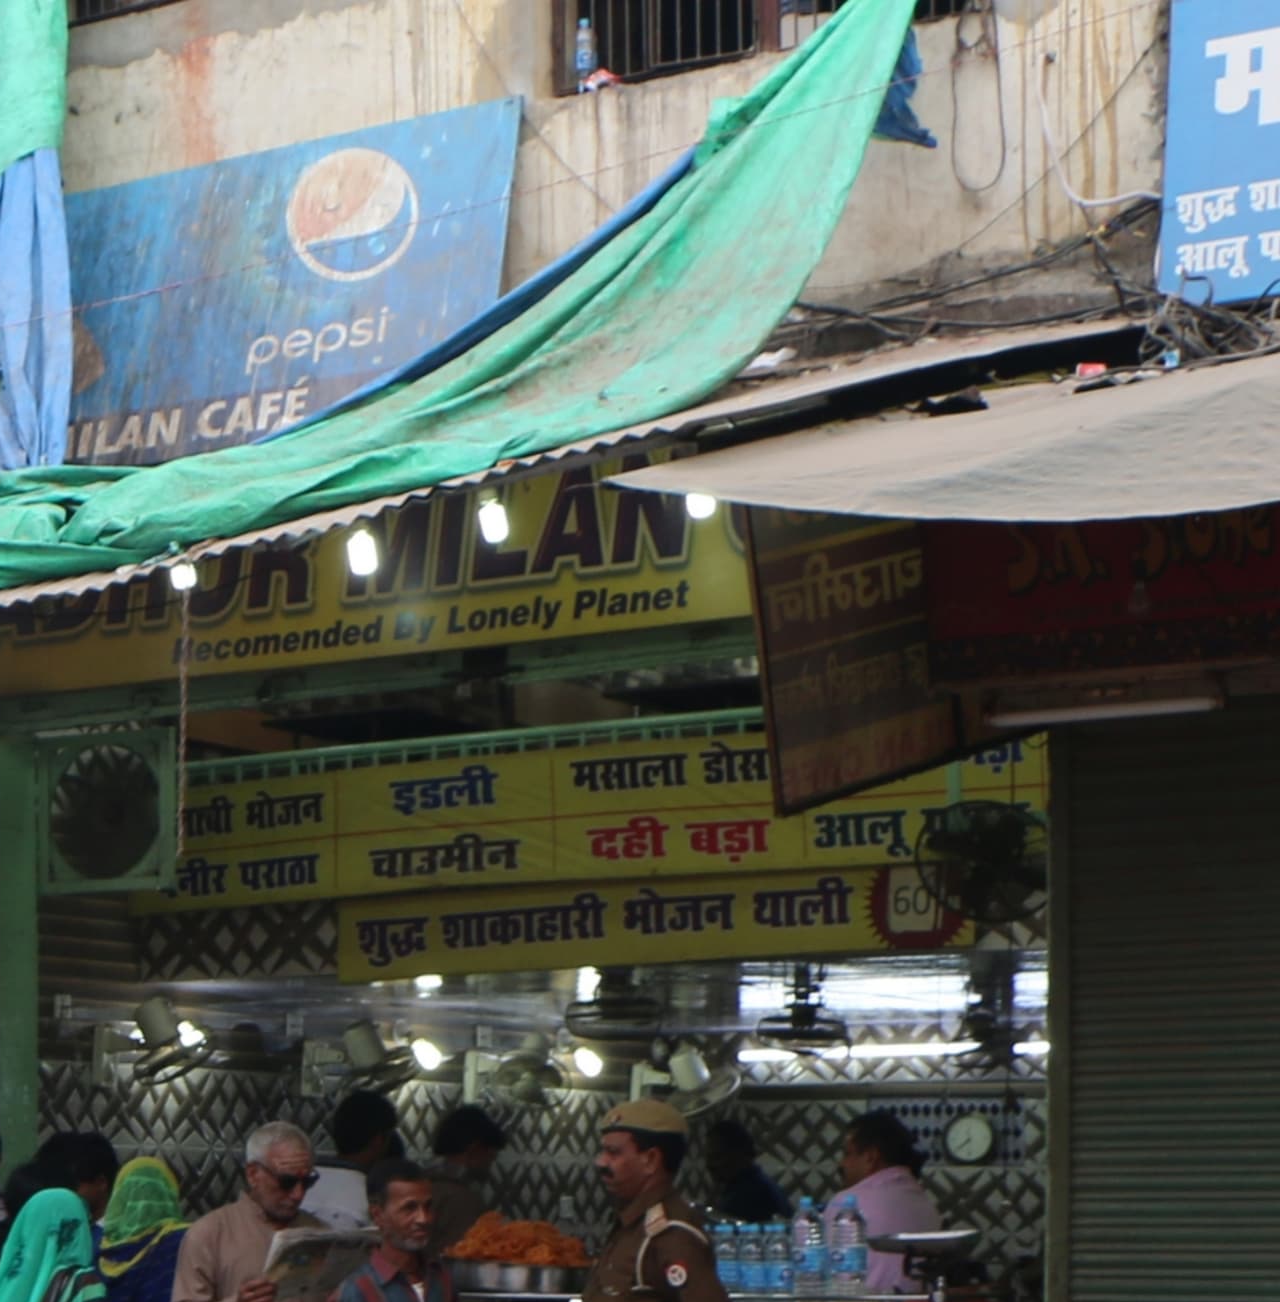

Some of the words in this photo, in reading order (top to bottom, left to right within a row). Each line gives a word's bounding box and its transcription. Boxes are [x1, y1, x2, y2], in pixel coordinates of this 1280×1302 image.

[1175, 185, 1241, 233] शुद्ध
[1175, 235, 1250, 278] आलू
[244, 306, 392, 375] pepsi
[196, 377, 310, 440] CAFÉ
[172, 616, 381, 665] Recomended
[393, 610, 435, 645] By
[447, 596, 562, 634] Lonely
[572, 580, 690, 620] Planet
[389, 764, 499, 816] इडली
[569, 753, 689, 792] मसाला
[699, 741, 770, 785] डोस
[244, 791, 325, 830] भोजन
[586, 816, 670, 861] दही
[813, 809, 913, 857] आलू
[162, 855, 228, 897] नीर
[238, 853, 321, 891] पराठा
[368, 833, 521, 879] चाउमीन
[356, 916, 430, 967] शुद्ध
[438, 892, 609, 951] शाकाहारी
[623, 887, 737, 936] भोजन
[752, 875, 855, 929] थाली
